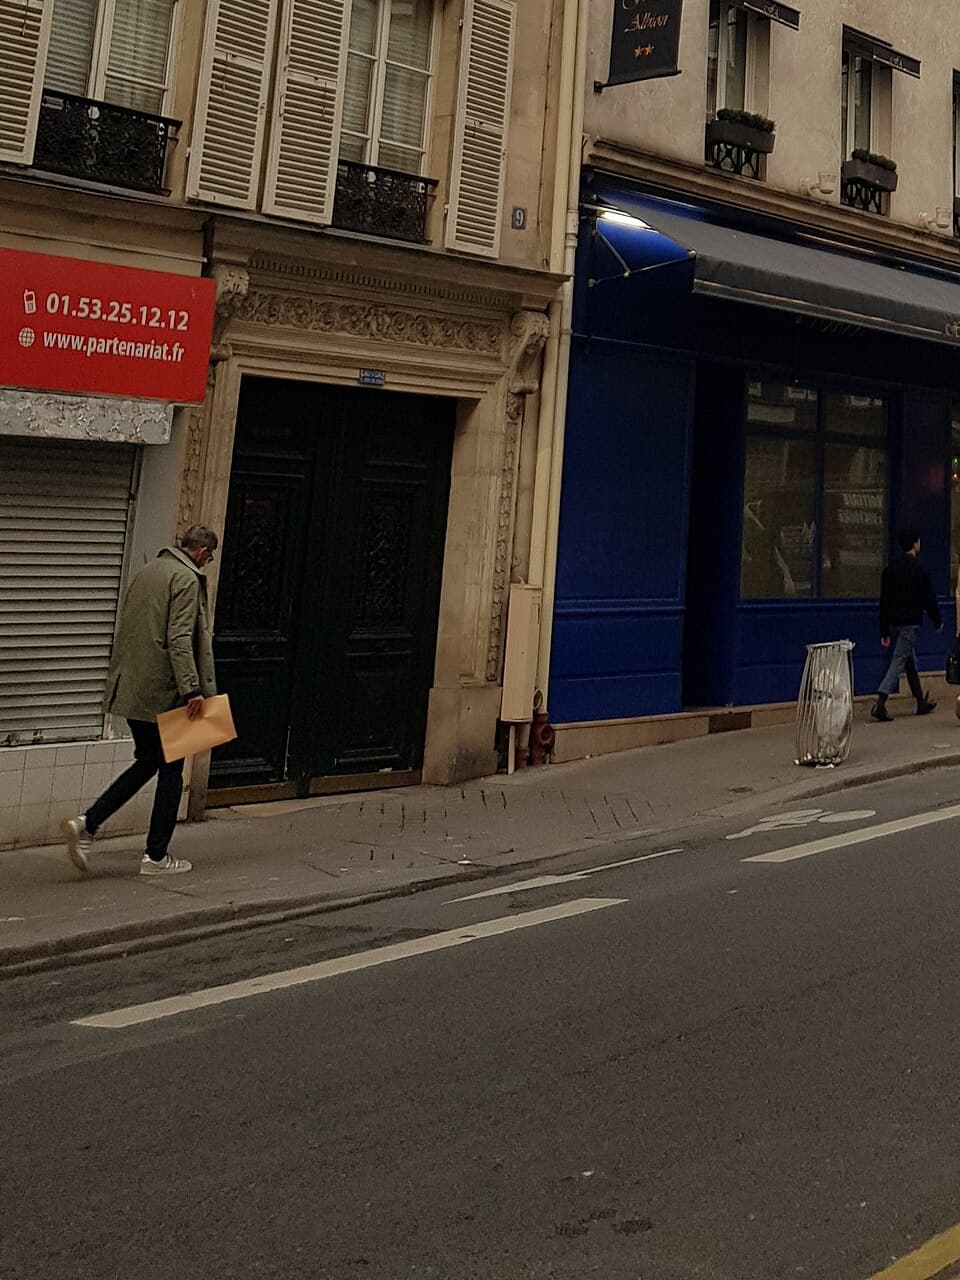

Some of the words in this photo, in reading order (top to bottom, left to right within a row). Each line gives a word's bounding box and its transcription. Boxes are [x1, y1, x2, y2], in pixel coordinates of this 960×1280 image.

[516, 209, 524, 227] 9
[46, 293, 189, 331] 01.53.25.12.12
[43, 331, 185, 362] www.partenariat.fr
